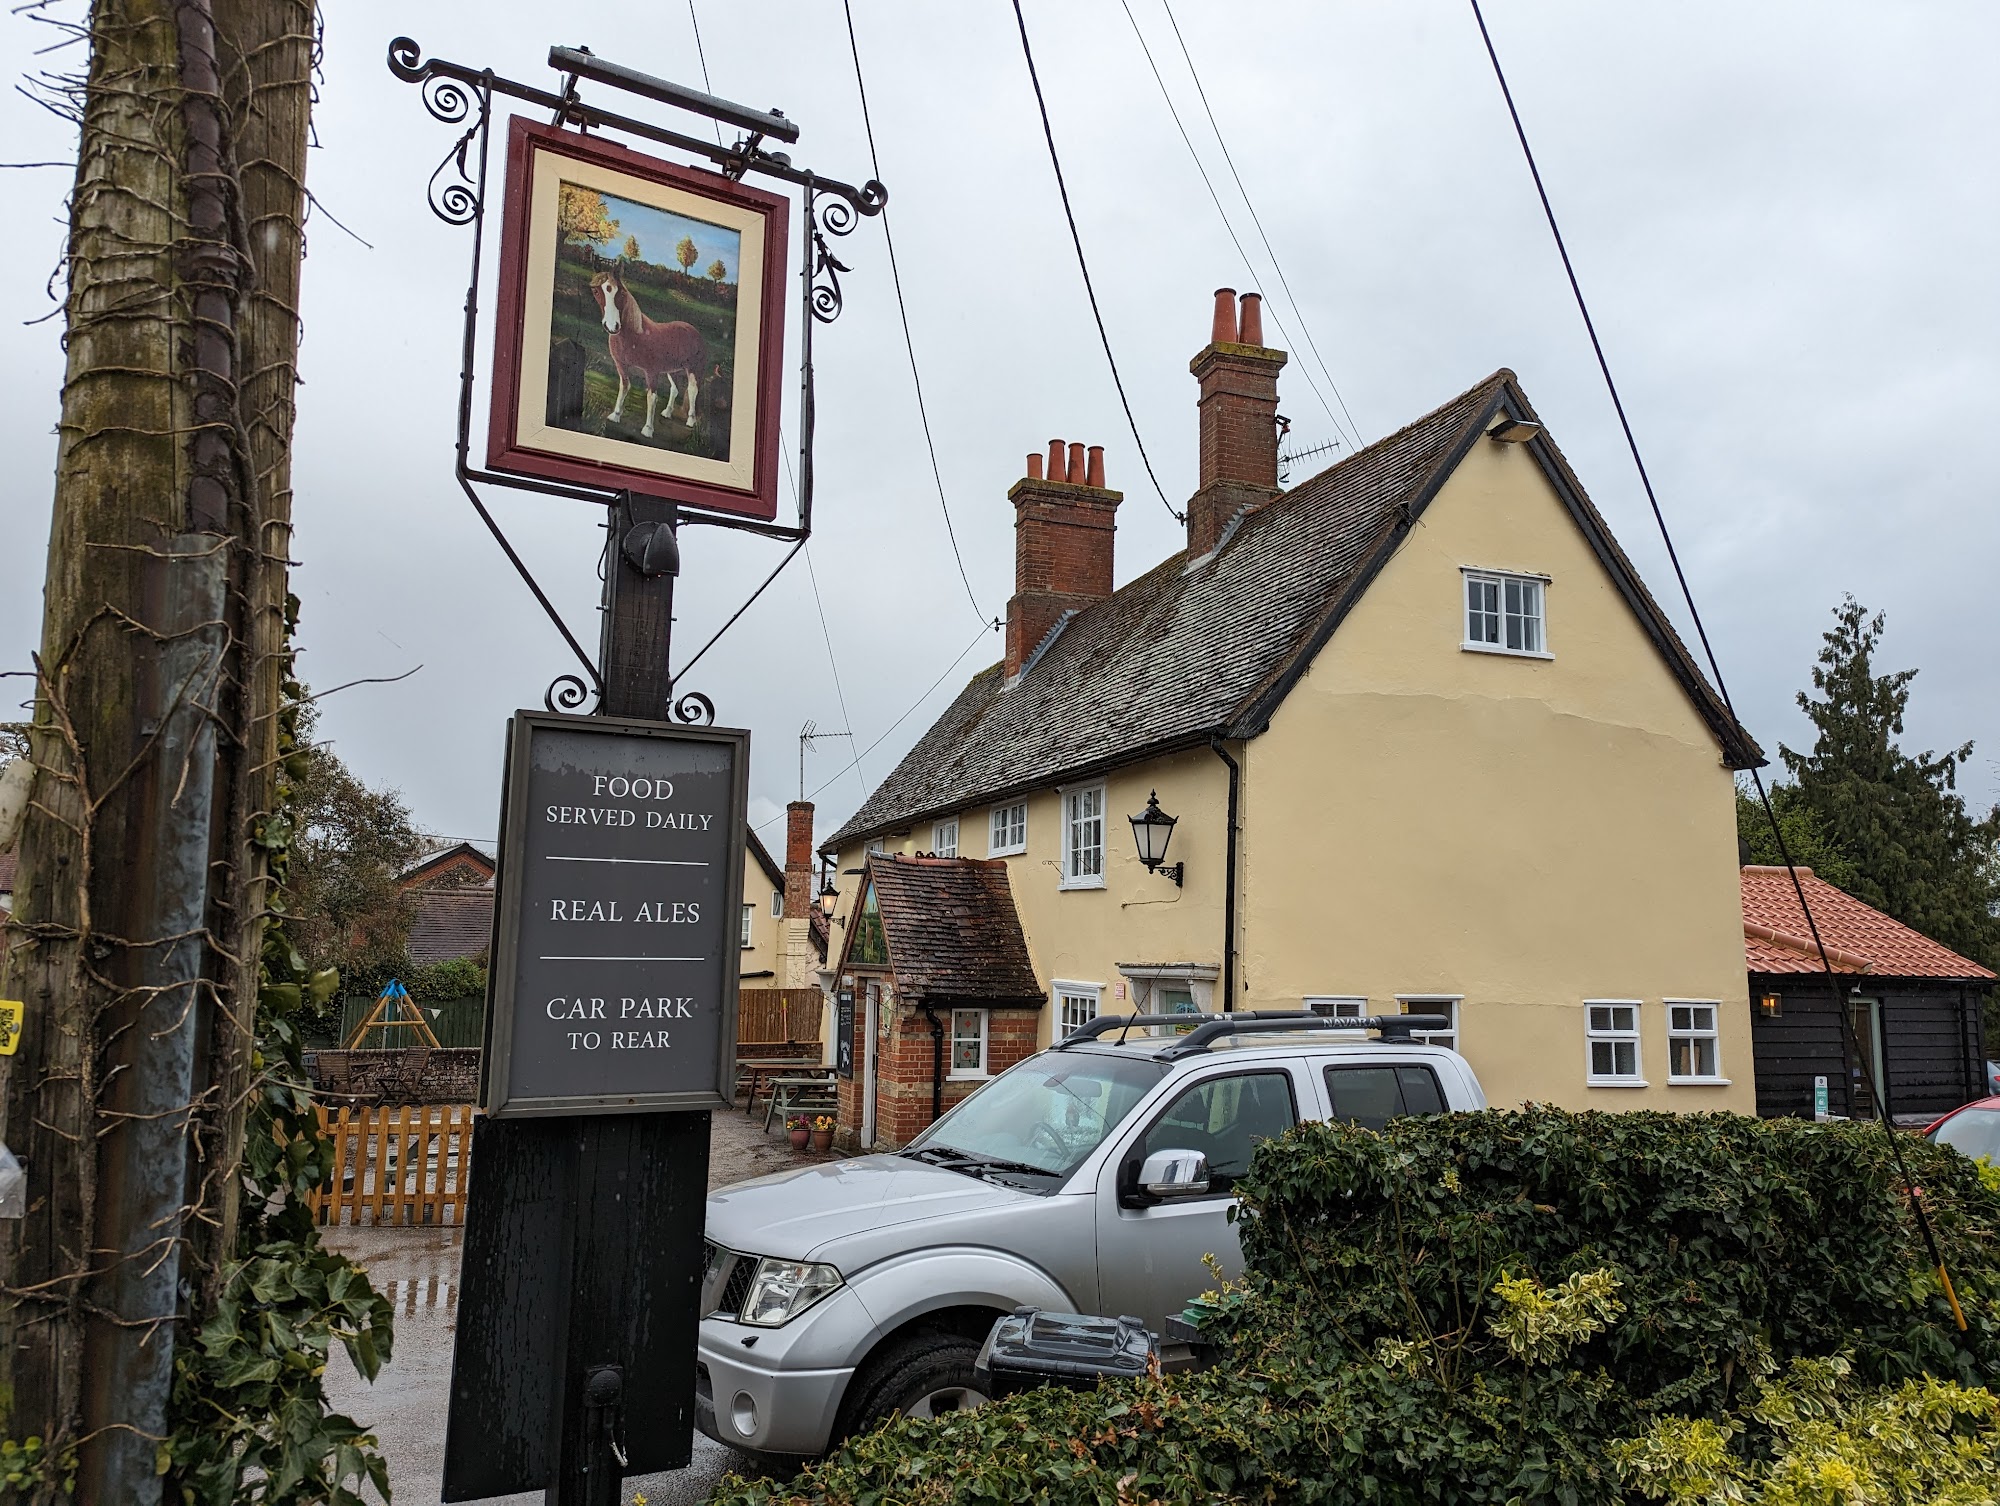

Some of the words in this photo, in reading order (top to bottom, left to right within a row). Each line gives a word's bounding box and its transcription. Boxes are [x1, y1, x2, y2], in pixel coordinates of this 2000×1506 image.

[592, 775, 674, 800] FOOD
[546, 805, 636, 827] SERVED
[645, 811, 713, 831] DAILY
[550, 899, 623, 922] REAL
[633, 901, 700, 924] ALES
[546, 997, 607, 1020] CAR
[619, 997, 694, 1019] PARK
[1322, 1017, 1378, 1028] NAVARA
[567, 1031, 601, 1050] TO
[611, 1030, 671, 1049] REAR
